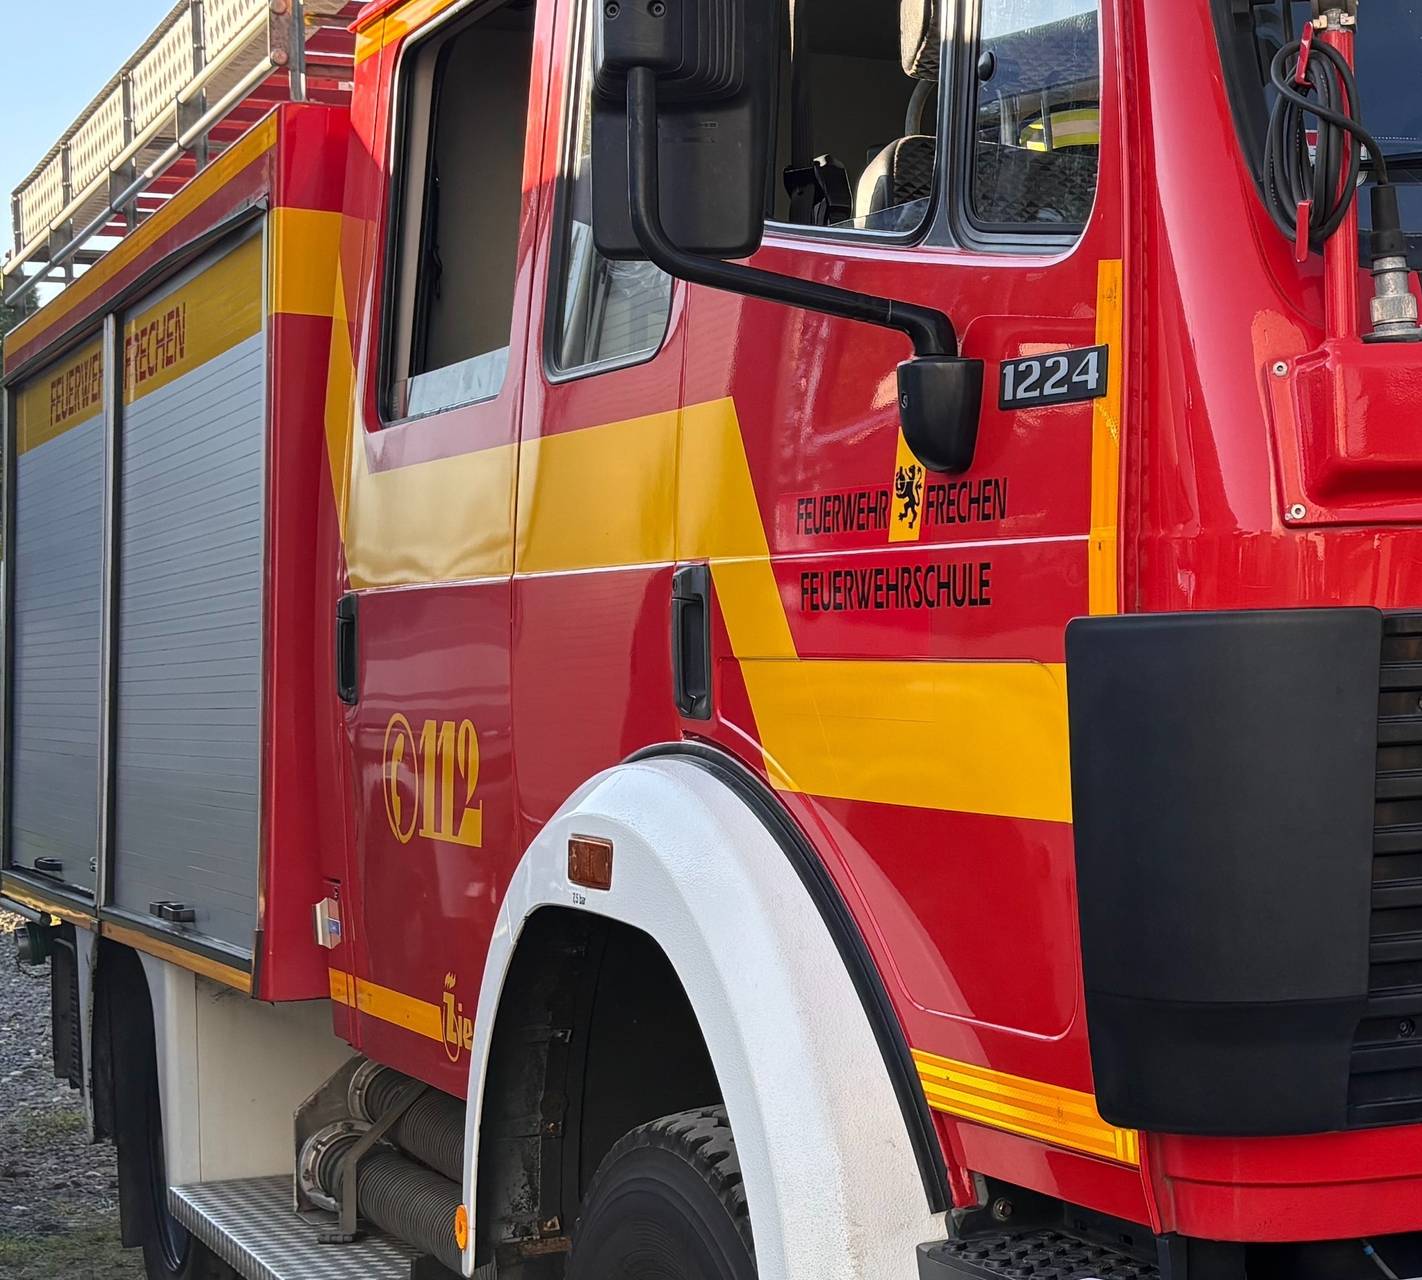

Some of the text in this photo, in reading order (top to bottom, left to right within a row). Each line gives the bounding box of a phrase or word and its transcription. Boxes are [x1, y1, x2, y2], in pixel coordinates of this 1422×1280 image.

[50, 351, 104, 426] FEUERWEH
[1002, 351, 1099, 401] 1224
[796, 478, 1008, 535] FEUERWEHR FRECHEN
[801, 562, 992, 612] FEUERWEHRSCHULE
[419, 718, 482, 848] 112
